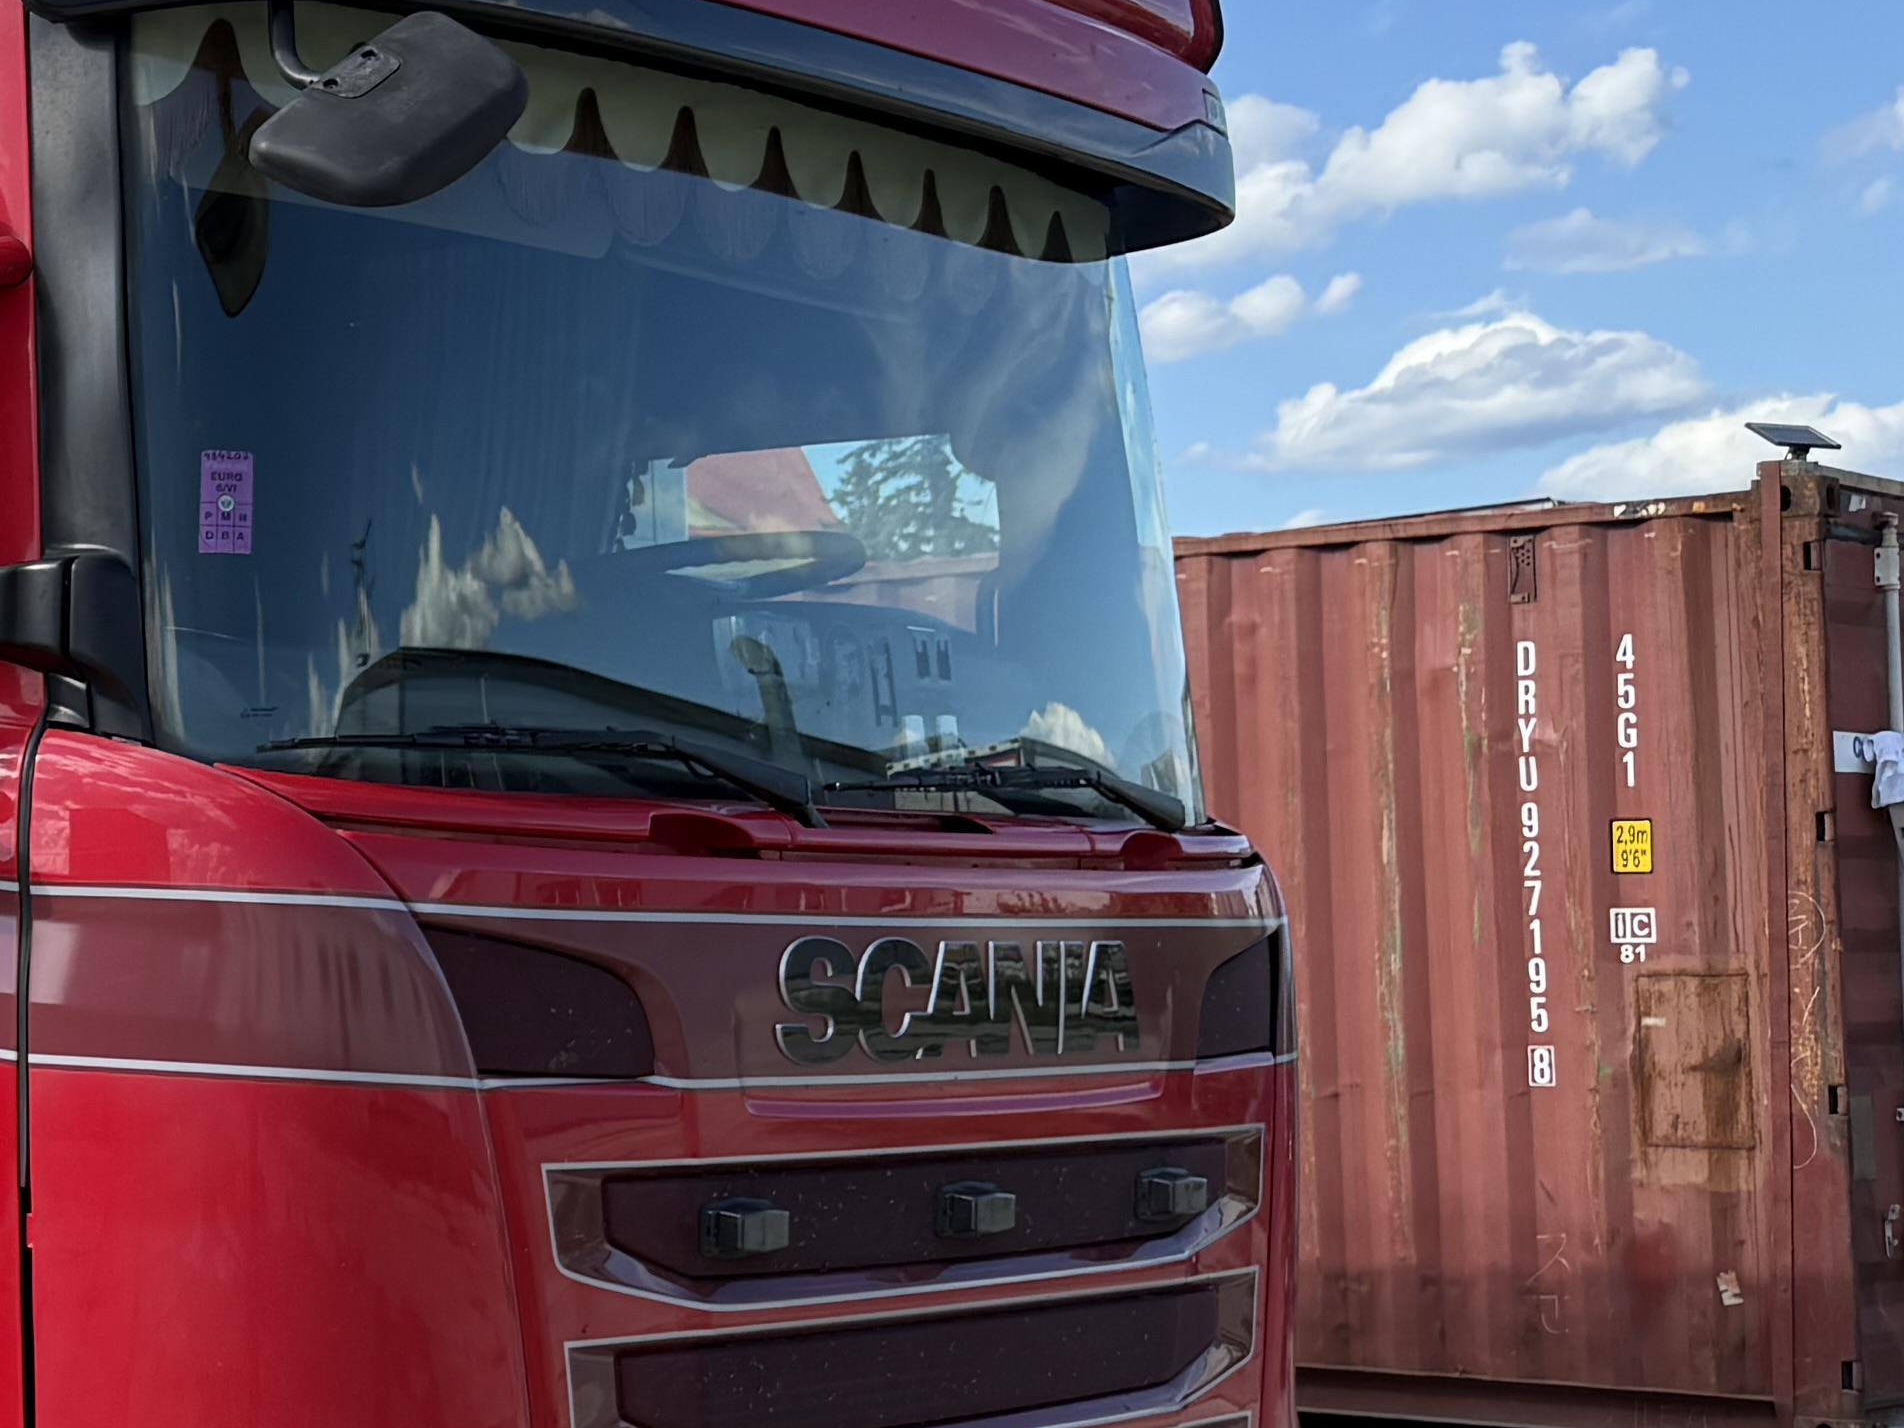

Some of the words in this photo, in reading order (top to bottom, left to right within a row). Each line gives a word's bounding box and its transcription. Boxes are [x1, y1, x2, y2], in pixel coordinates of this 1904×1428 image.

[211, 472, 243, 483] EURO
[1516, 640, 1538, 792] DRYU
[1615, 633, 1638, 788] 45G1
[1521, 802, 1549, 1033] 927195
[1620, 944, 1646, 964] 81
[775, 936, 1140, 1065] SCANIA
[1533, 1048, 1552, 1082] 8
